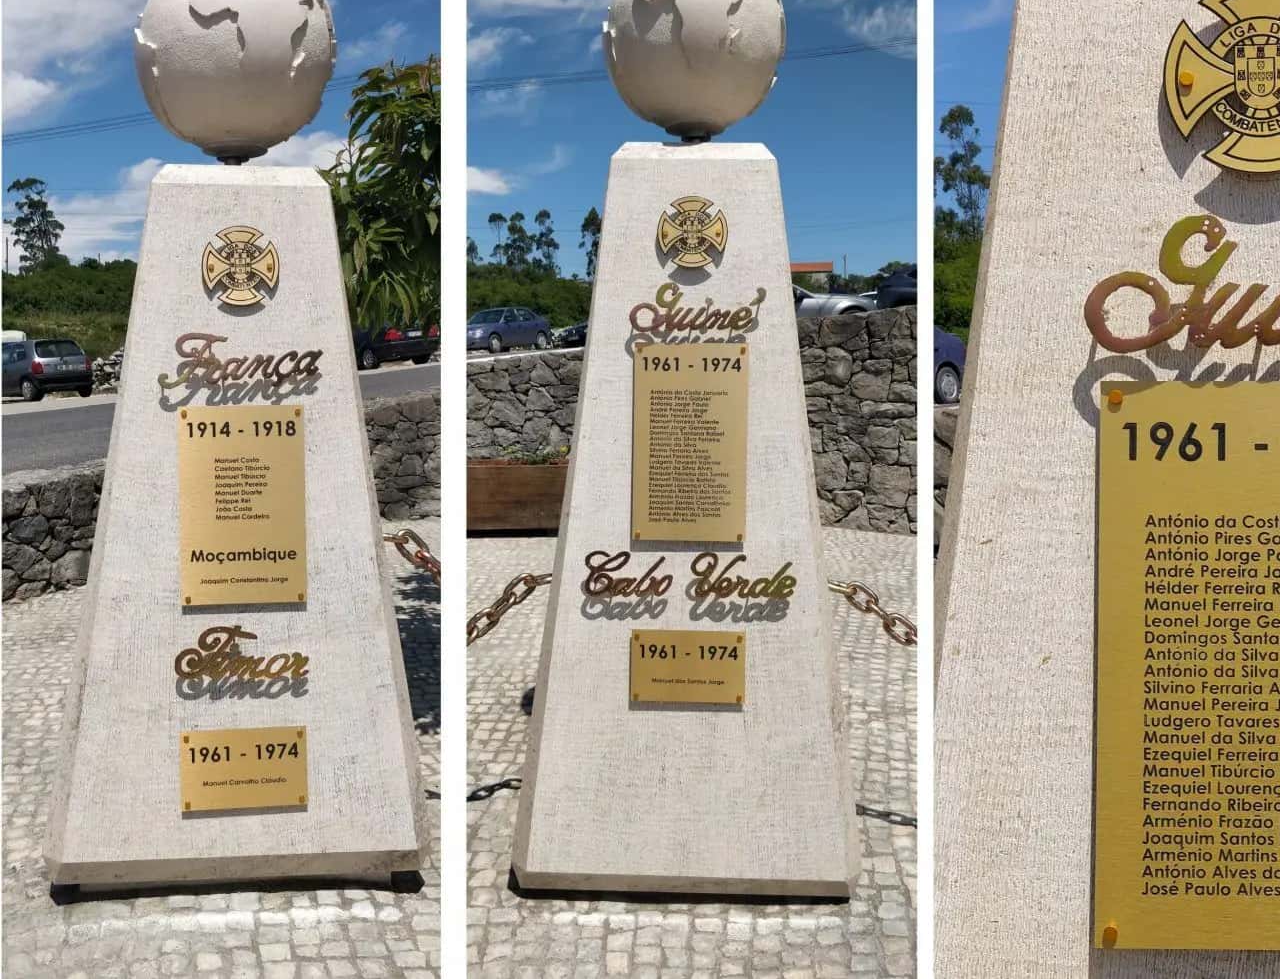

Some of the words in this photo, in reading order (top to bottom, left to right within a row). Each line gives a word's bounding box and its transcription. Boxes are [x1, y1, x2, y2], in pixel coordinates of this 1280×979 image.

[1220, 22, 1257, 48] LIGA
[158, 332, 323, 388] França
[642, 357, 680, 371] 1961
[702, 358, 742, 372] 1974
[186, 421, 231, 438] 1914
[253, 420, 296, 437] 1918
[1122, 422, 1226, 461] 1961
[1145, 514, 1209, 528] António
[1215, 515, 1236, 528] da
[1145, 531, 1208, 545] António
[1215, 532, 1252, 545] Pires
[190, 546, 297, 564] Moçambique
[1145, 547, 1208, 561] António
[1215, 549, 1261, 565] Jorge
[584, 550, 673, 598] Cabo
[690, 552, 797, 598] Verde
[1145, 564, 1195, 578] André
[1201, 565, 1258, 578] Pereira
[1145, 580, 1199, 594] Hélder
[1205, 582, 1265, 595] Ferreira
[1144, 597, 1206, 610] Manuel
[1213, 598, 1273, 611] Ferreira
[1145, 614, 1198, 627] Leonel
[1204, 615, 1251, 631] Jorge
[1145, 631, 1227, 647] Domingos
[639, 644, 677, 659] 1961
[699, 646, 738, 661] 1974
[1144, 647, 1208, 661] António
[1214, 648, 1238, 661] da
[1241, 648, 1278, 661] Silva
[1144, 664, 1208, 678] António
[1214, 665, 1235, 678] da
[1242, 665, 1278, 678] Silva
[1144, 681, 1195, 694] Silvino
[1202, 681, 1262, 694] Ferraria
[1144, 697, 1205, 710] Manuel
[1212, 698, 1268, 711] Pereira
[1144, 714, 1211, 730] Ludgero
[1218, 715, 1279, 728] Tavares
[1143, 731, 1205, 744] Manuel
[1211, 731, 1232, 744] da
[1239, 732, 1276, 745] Silva
[189, 746, 231, 763] 1961
[255, 742, 299, 760] 1974
[1144, 748, 1211, 764] Ezequiel
[1218, 748, 1278, 761] Ferreira
[1143, 764, 1205, 777] Manuel
[1212, 764, 1275, 778] Tibúrcio
[1143, 781, 1211, 797] Ezequiel
[1143, 798, 1221, 811] Fernando
[1142, 814, 1213, 828] Arménio
[1219, 816, 1273, 829] Frazão
[1142, 832, 1214, 848] Joaquim
[1220, 832, 1274, 845] Santos
[1142, 848, 1212, 862] Arménio
[1218, 849, 1277, 862] Martins
[1142, 865, 1206, 879] António
[1212, 866, 1256, 879] Alves
[1141, 881, 1179, 895] José
[1185, 883, 1231, 896] Paulo
[1237, 883, 1280, 896] Alves
